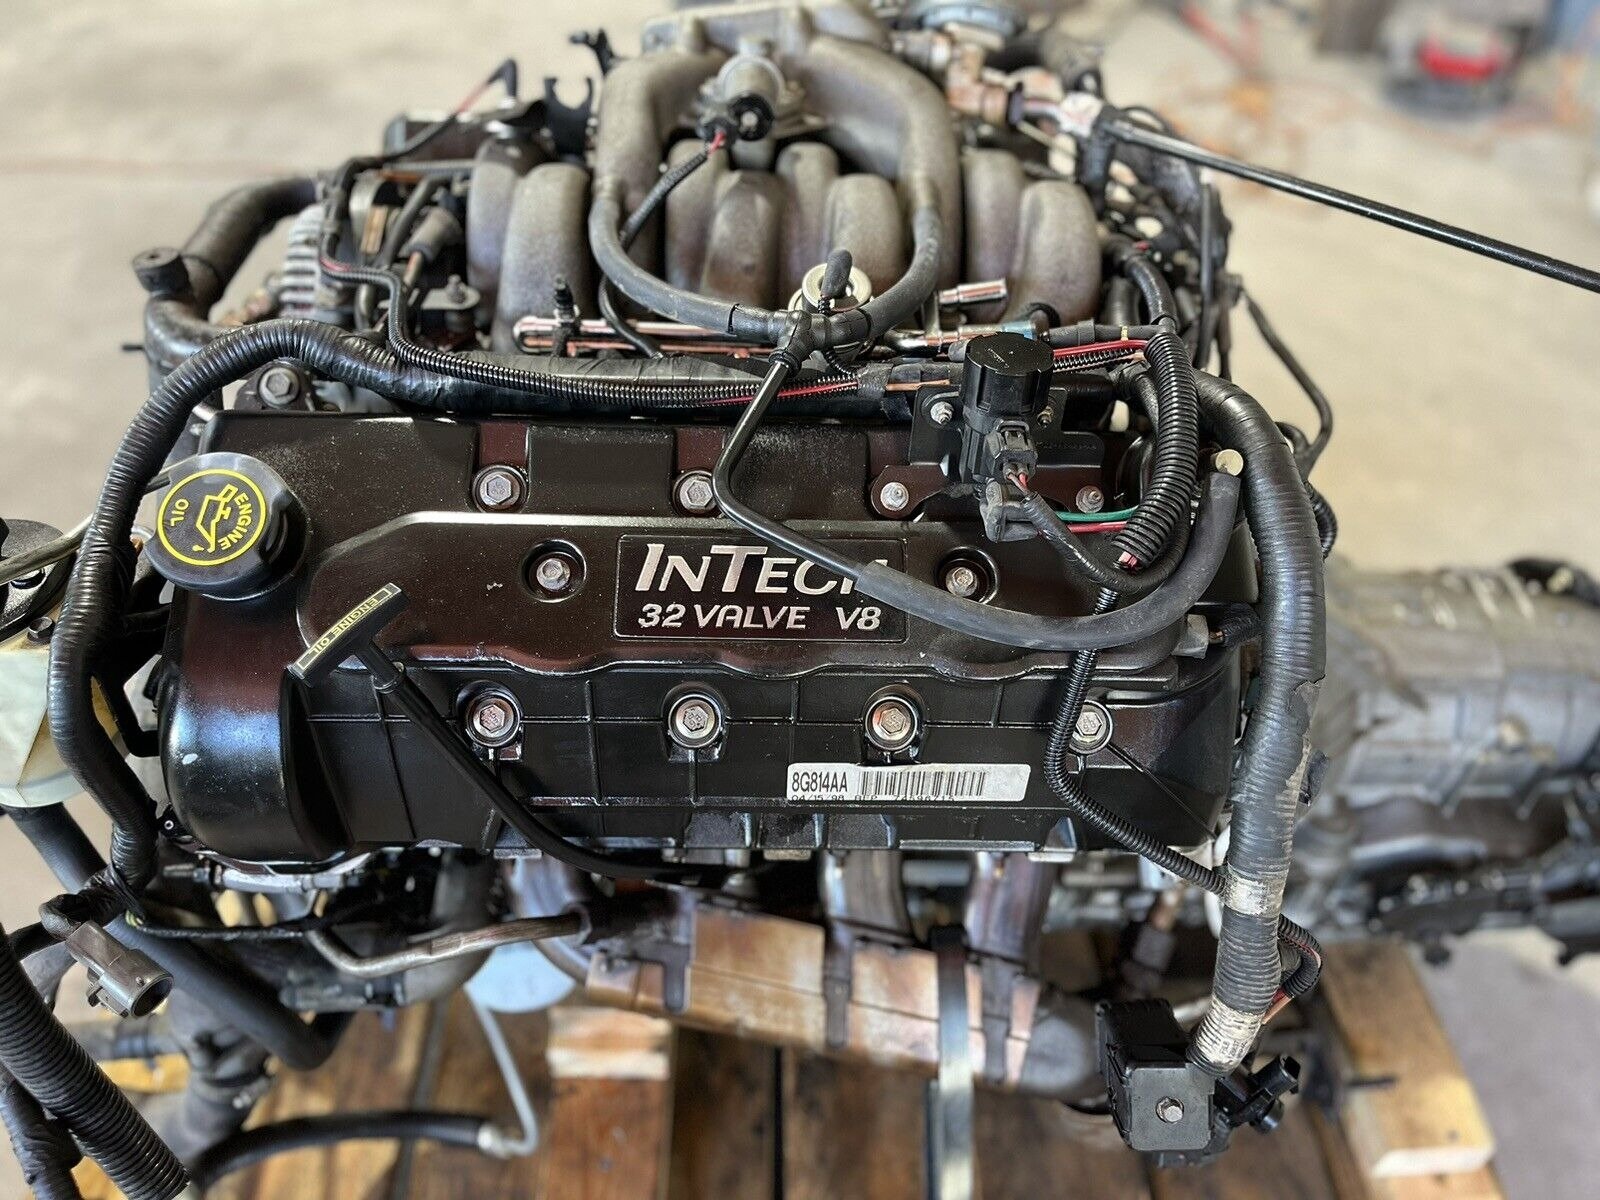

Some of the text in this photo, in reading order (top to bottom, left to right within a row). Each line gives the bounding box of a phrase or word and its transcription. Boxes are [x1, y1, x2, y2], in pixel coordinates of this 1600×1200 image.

[170, 492, 253, 550] ENGINE OIL
[635, 543, 888, 595] INTEC
[308, 597, 379, 654] ENGINE OIL
[637, 603, 882, 631] 32 VALVE V8
[791, 771, 849, 793] 8G814AA
